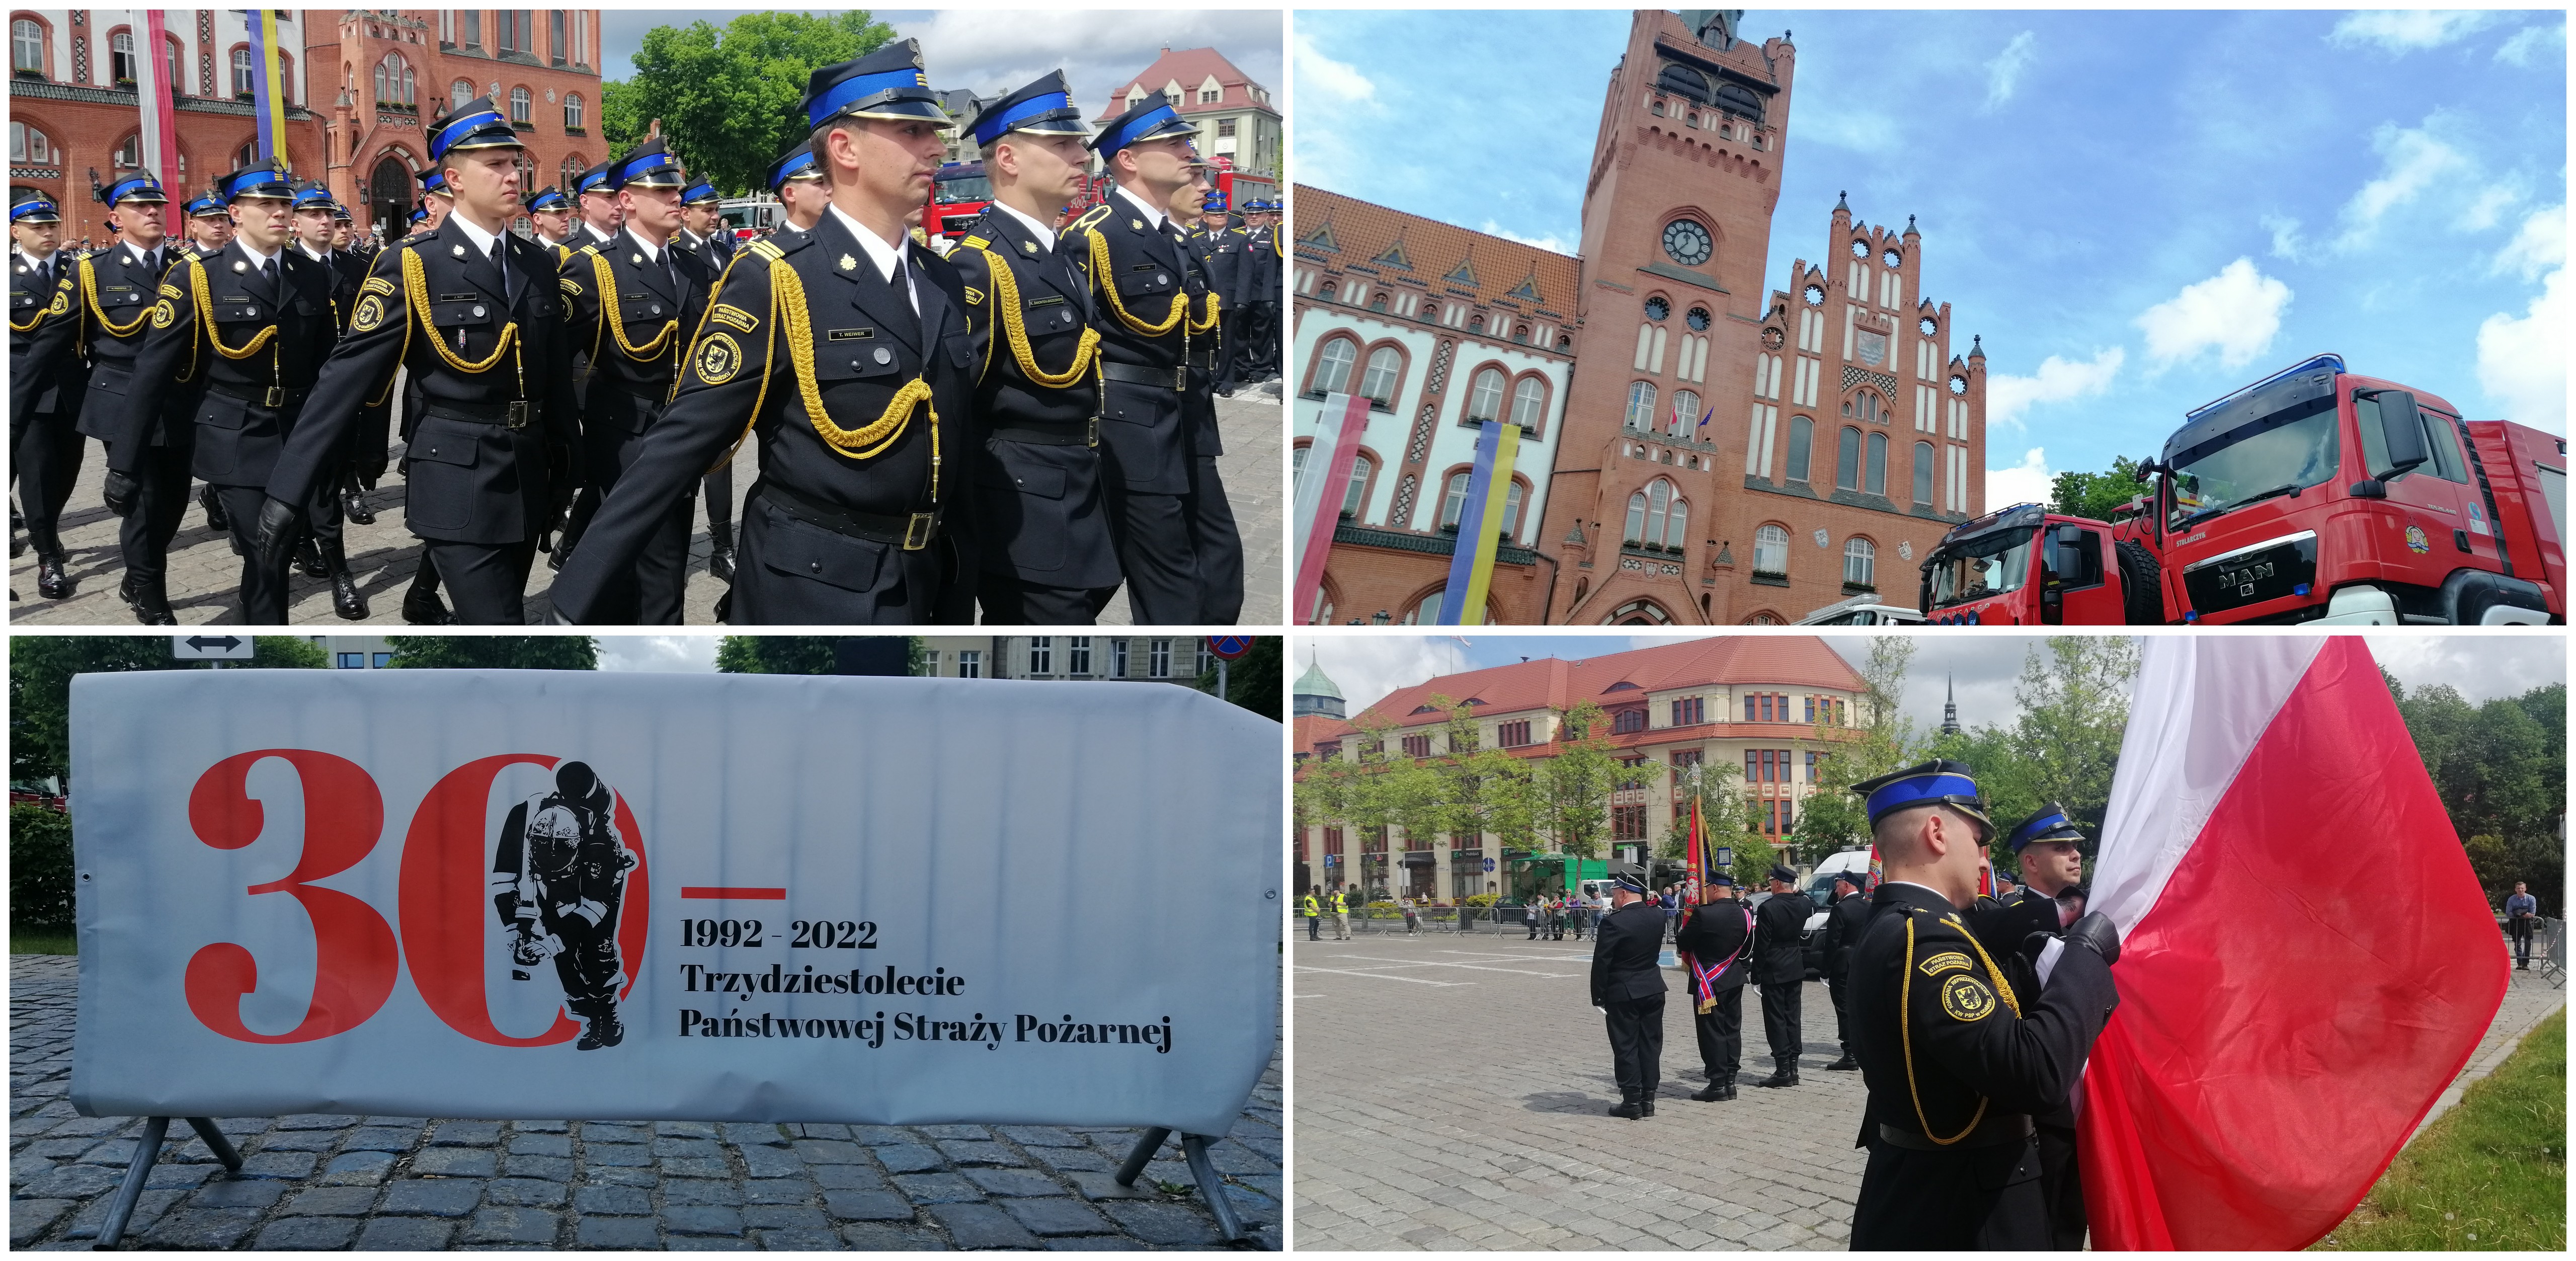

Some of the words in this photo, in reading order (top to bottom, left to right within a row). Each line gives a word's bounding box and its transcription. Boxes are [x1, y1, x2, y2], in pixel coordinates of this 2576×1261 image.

[718, 307, 747, 322] PAŃSTWOWA
[699, 336, 714, 355] KOMPANIA
[714, 335, 739, 369] REPREZENTACYJNA
[697, 359, 703, 367] KW
[699, 367, 707, 376] PSP
[710, 371, 731, 381] GDAŃSKU
[2176, 531, 2206, 547] STOLARCZYK
[2219, 562, 2274, 589] MAN
[185, 748, 650, 1047] 30
[680, 919, 763, 948] 1992
[790, 920, 877, 949] 2022
[1931, 955, 1964, 965] PAŃSTWOWA
[680, 964, 965, 1002] Trzydziestolecie
[1945, 985, 1954, 1009] KOMPANIA
[1951, 977, 1990, 996] REPREZENTACYJNA
[1980, 998, 1993, 1014] GDAŃSKU
[678, 1008, 885, 1049] Państwowej
[894, 1011, 1008, 1051] Straży
[1014, 1014, 1172, 1054] Pożarnej
